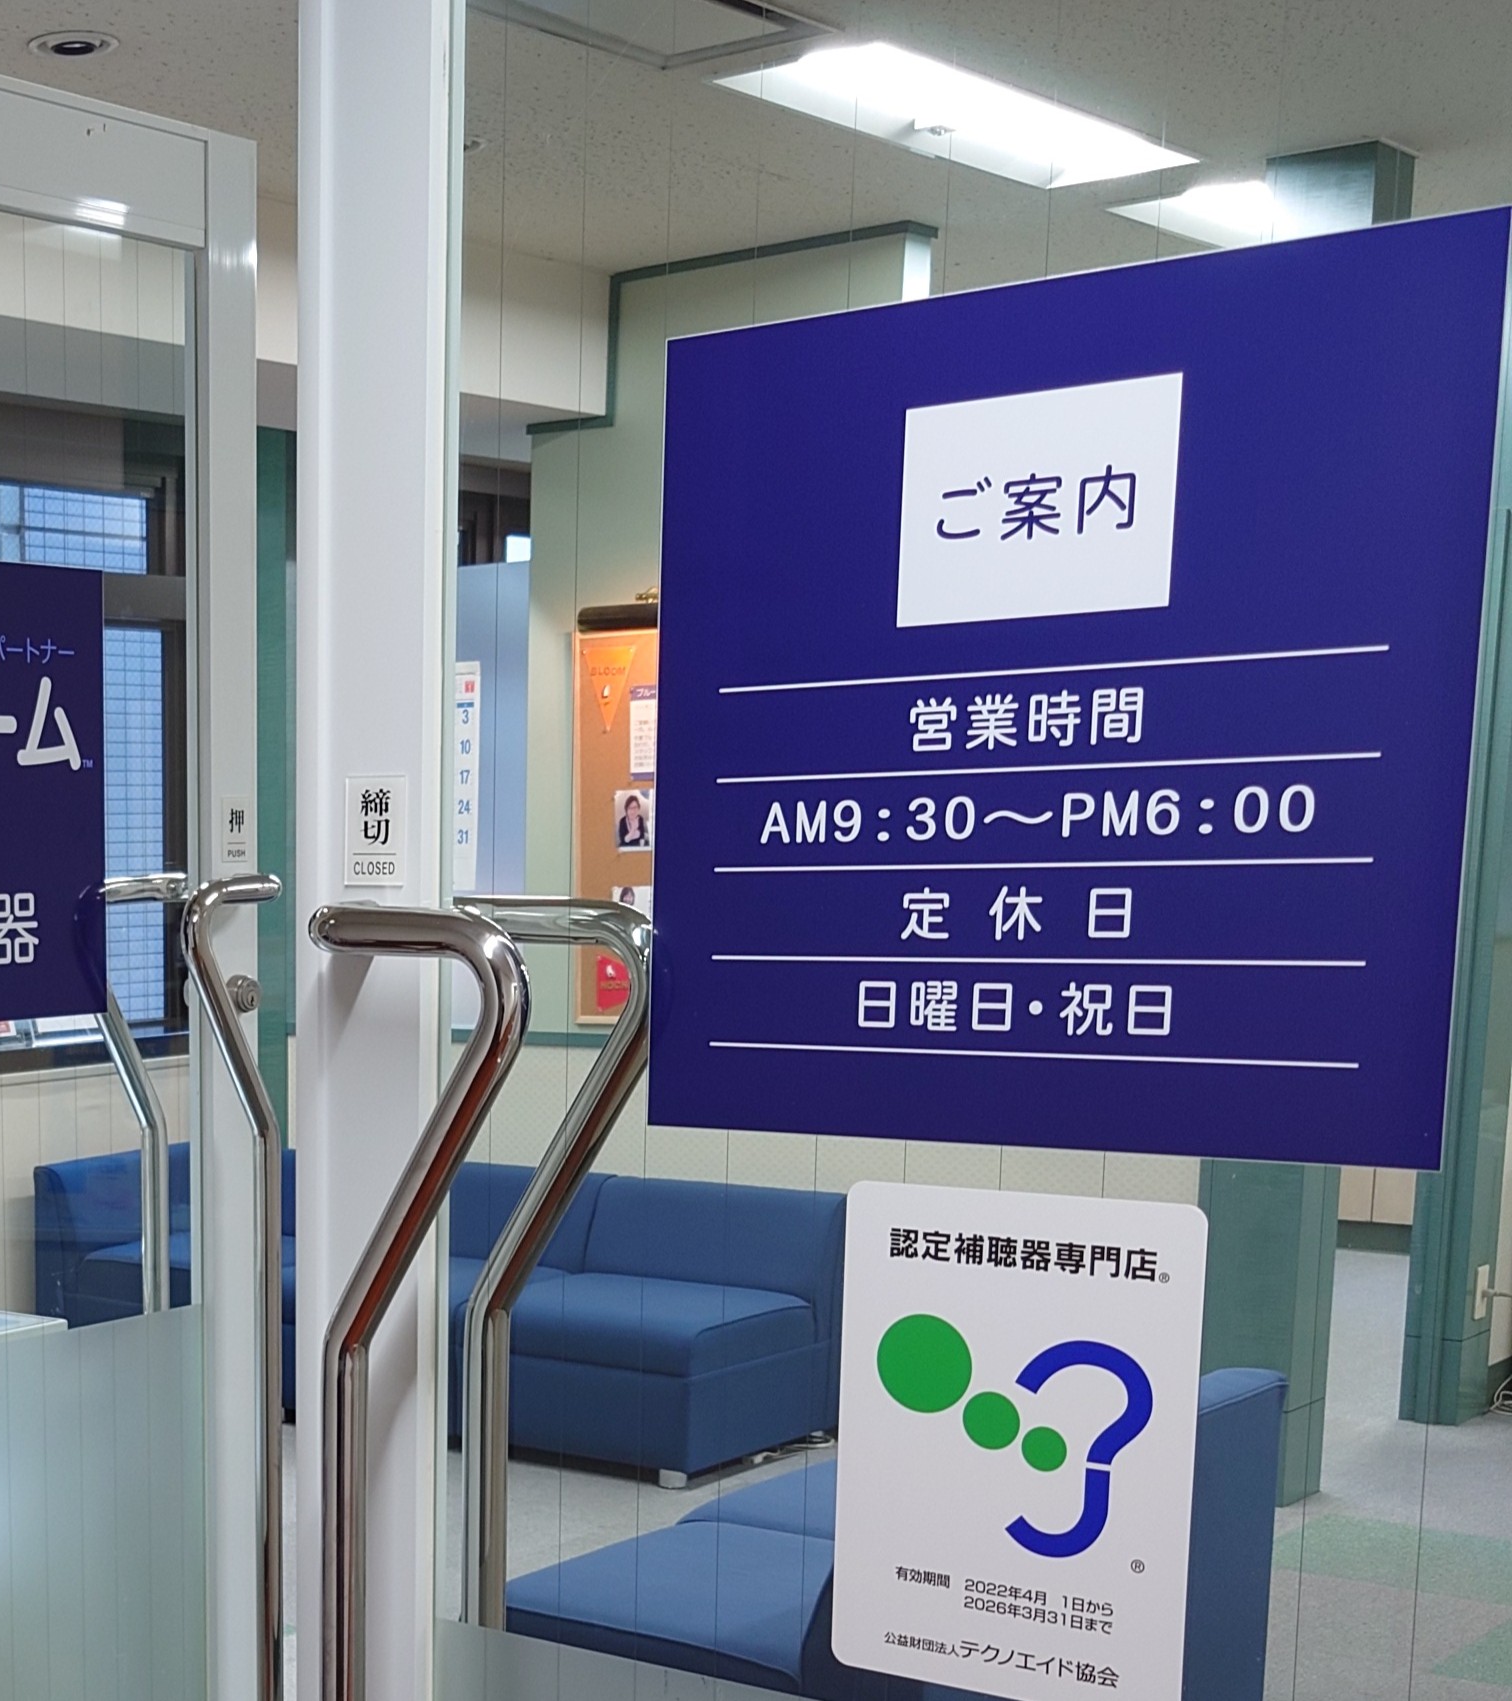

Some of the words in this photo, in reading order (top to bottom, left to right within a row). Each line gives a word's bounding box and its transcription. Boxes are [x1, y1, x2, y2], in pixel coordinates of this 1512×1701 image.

[936, 464, 1137, 541] ご案内
[462, 709, 469, 724] 3
[909, 686, 1144, 752] 営業時間
[460, 740, 471, 755] 10
[460, 769, 470, 785] 17
[360, 788, 391, 846] 締切
[458, 800, 470, 815] 24
[228, 808, 245, 834] 押
[457, 829, 469, 845] 31
[227, 849, 246, 858] PUSH
[353, 861, 395, 876] CLOSED
[857, 980, 1173, 1036] 日曜日・祝日
[889, 1227, 1157, 1282] 認定補聴器専門店
[895, 1566, 950, 1589] 有効期間
[963, 1596, 1113, 1635] 2026年3月31日まで
